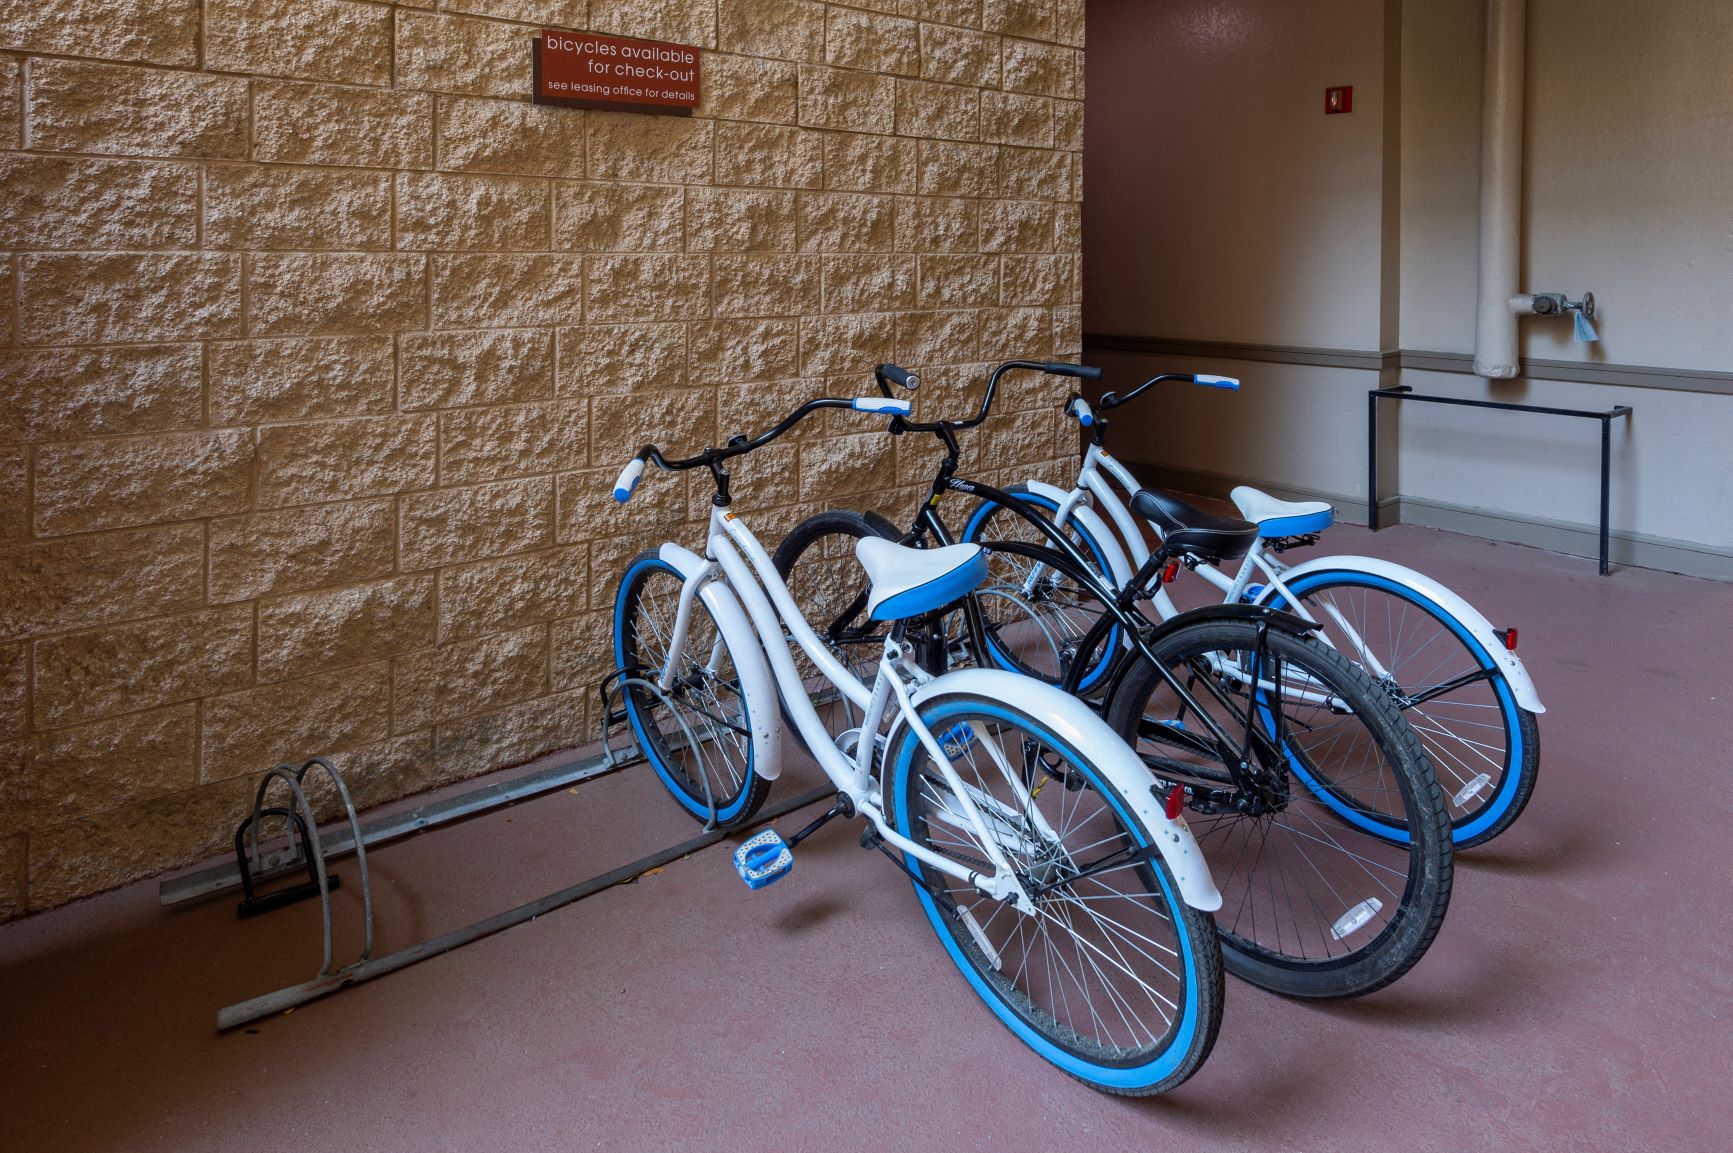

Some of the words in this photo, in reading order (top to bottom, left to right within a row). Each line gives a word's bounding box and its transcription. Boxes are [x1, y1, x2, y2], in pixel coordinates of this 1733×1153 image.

[547, 35, 617, 56] bicycles
[621, 46, 694, 64] available
[587, 59, 610, 74] for
[614, 63, 695, 82] check-out
[548, 81, 568, 90] see
[570, 81, 610, 96] leasing
[612, 85, 643, 97] office
[645, 87, 660, 98] for
[661, 89, 695, 101] details
